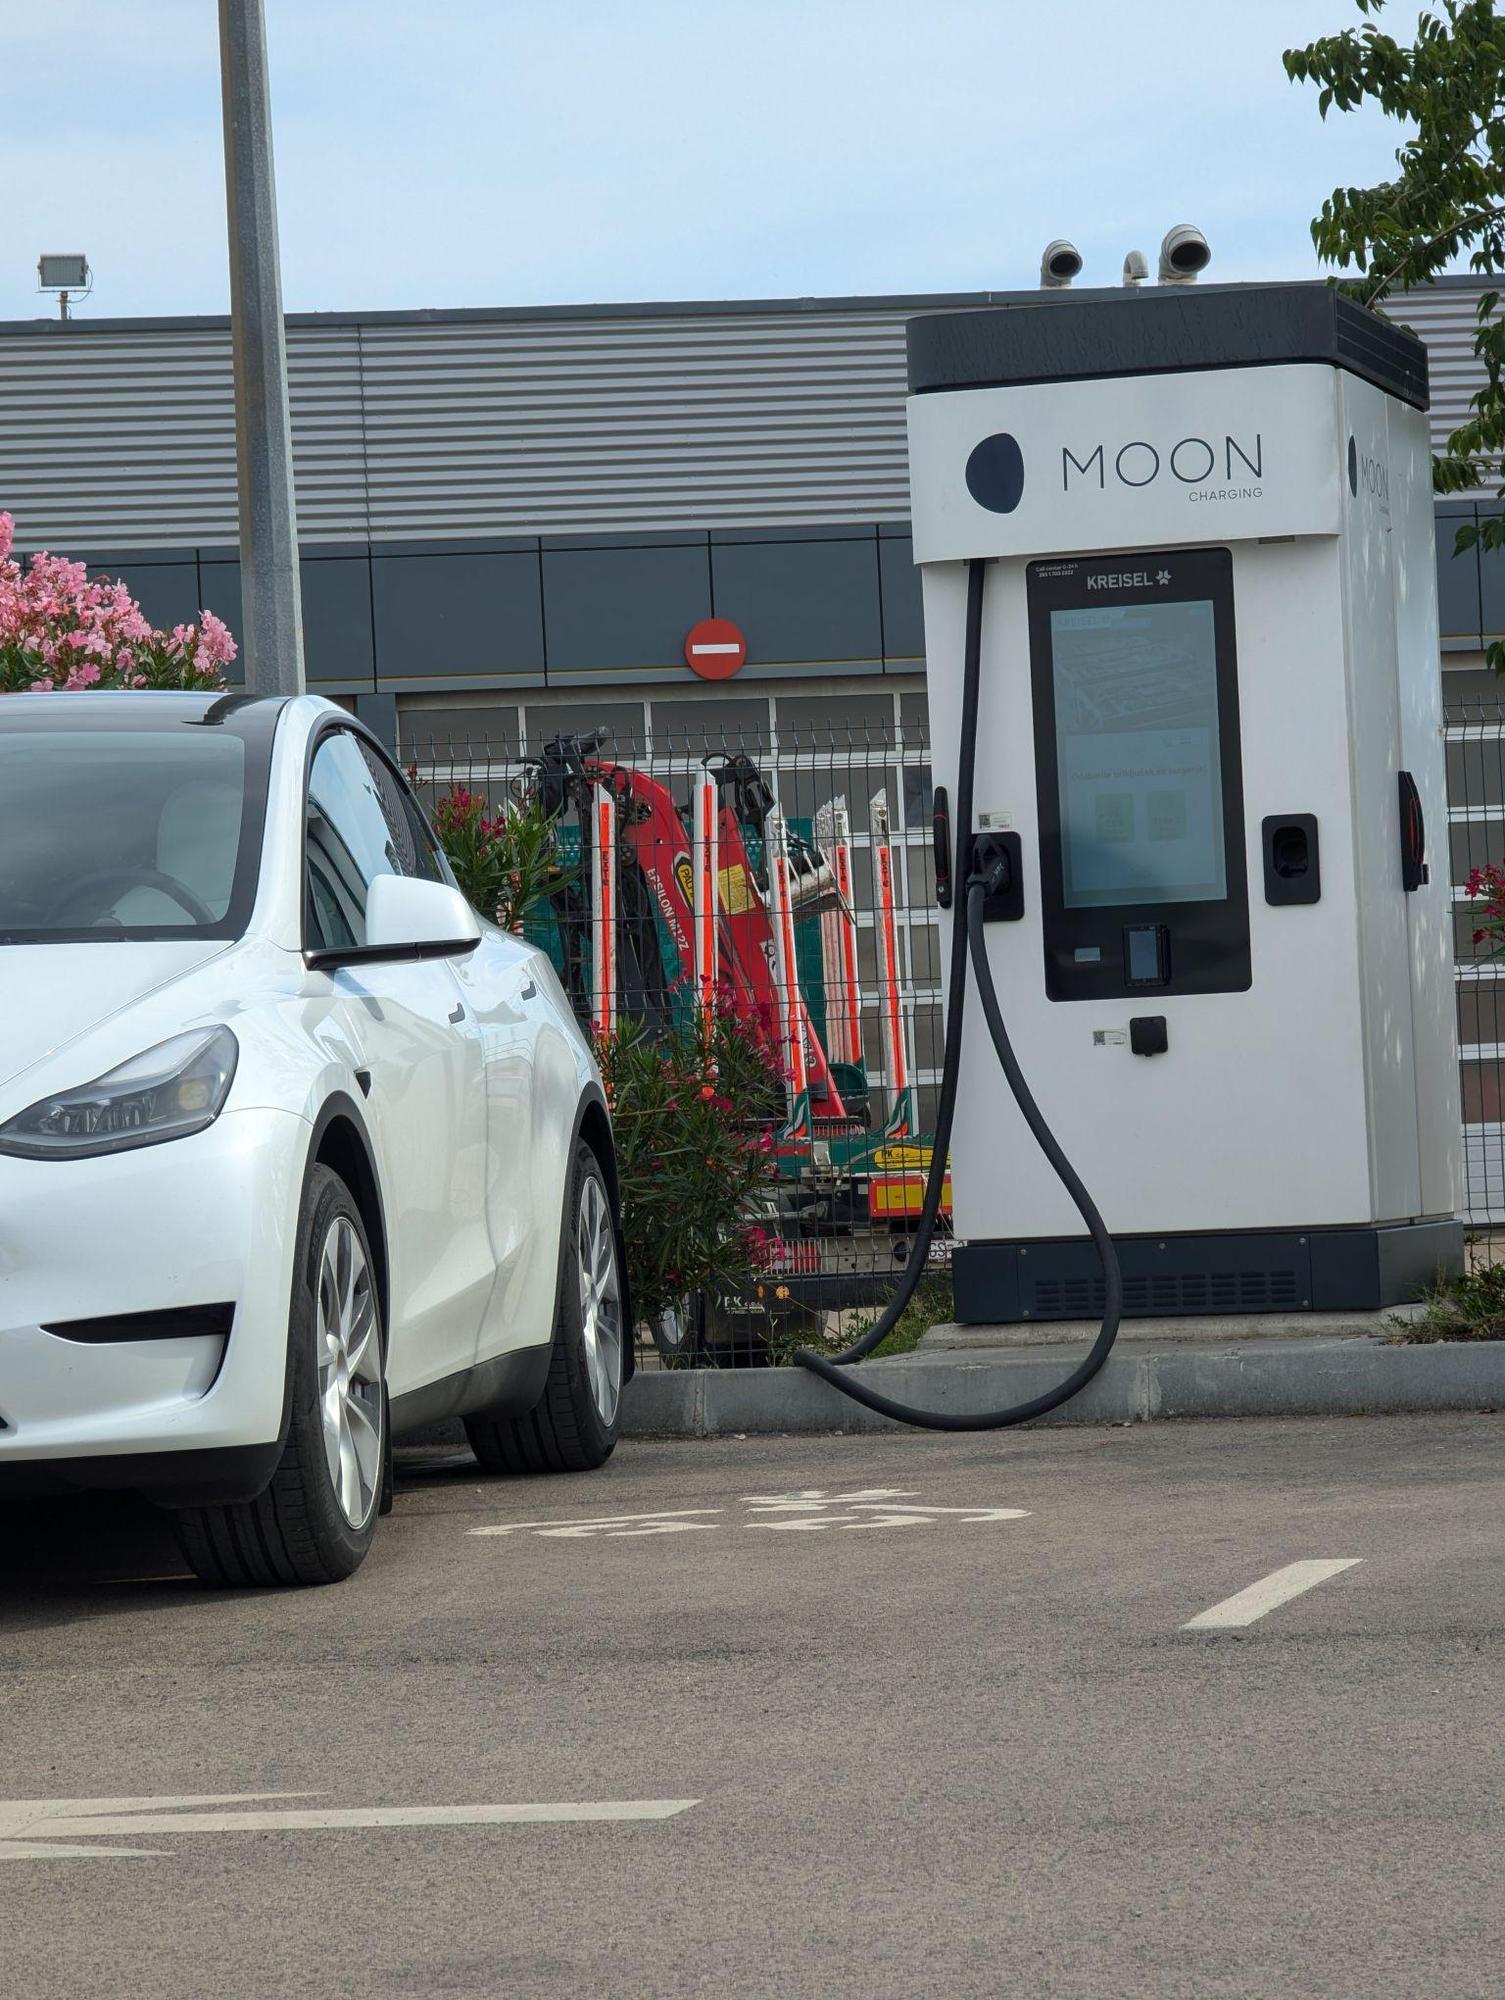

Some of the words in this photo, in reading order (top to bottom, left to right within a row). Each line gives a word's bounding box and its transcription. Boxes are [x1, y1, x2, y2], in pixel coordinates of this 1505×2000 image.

[1062, 434, 1262, 491] MOON
[1188, 487, 1263, 502] CHARGING
[1086, 571, 1153, 590] KREISEL
[647, 867, 675, 917] EPSILON
